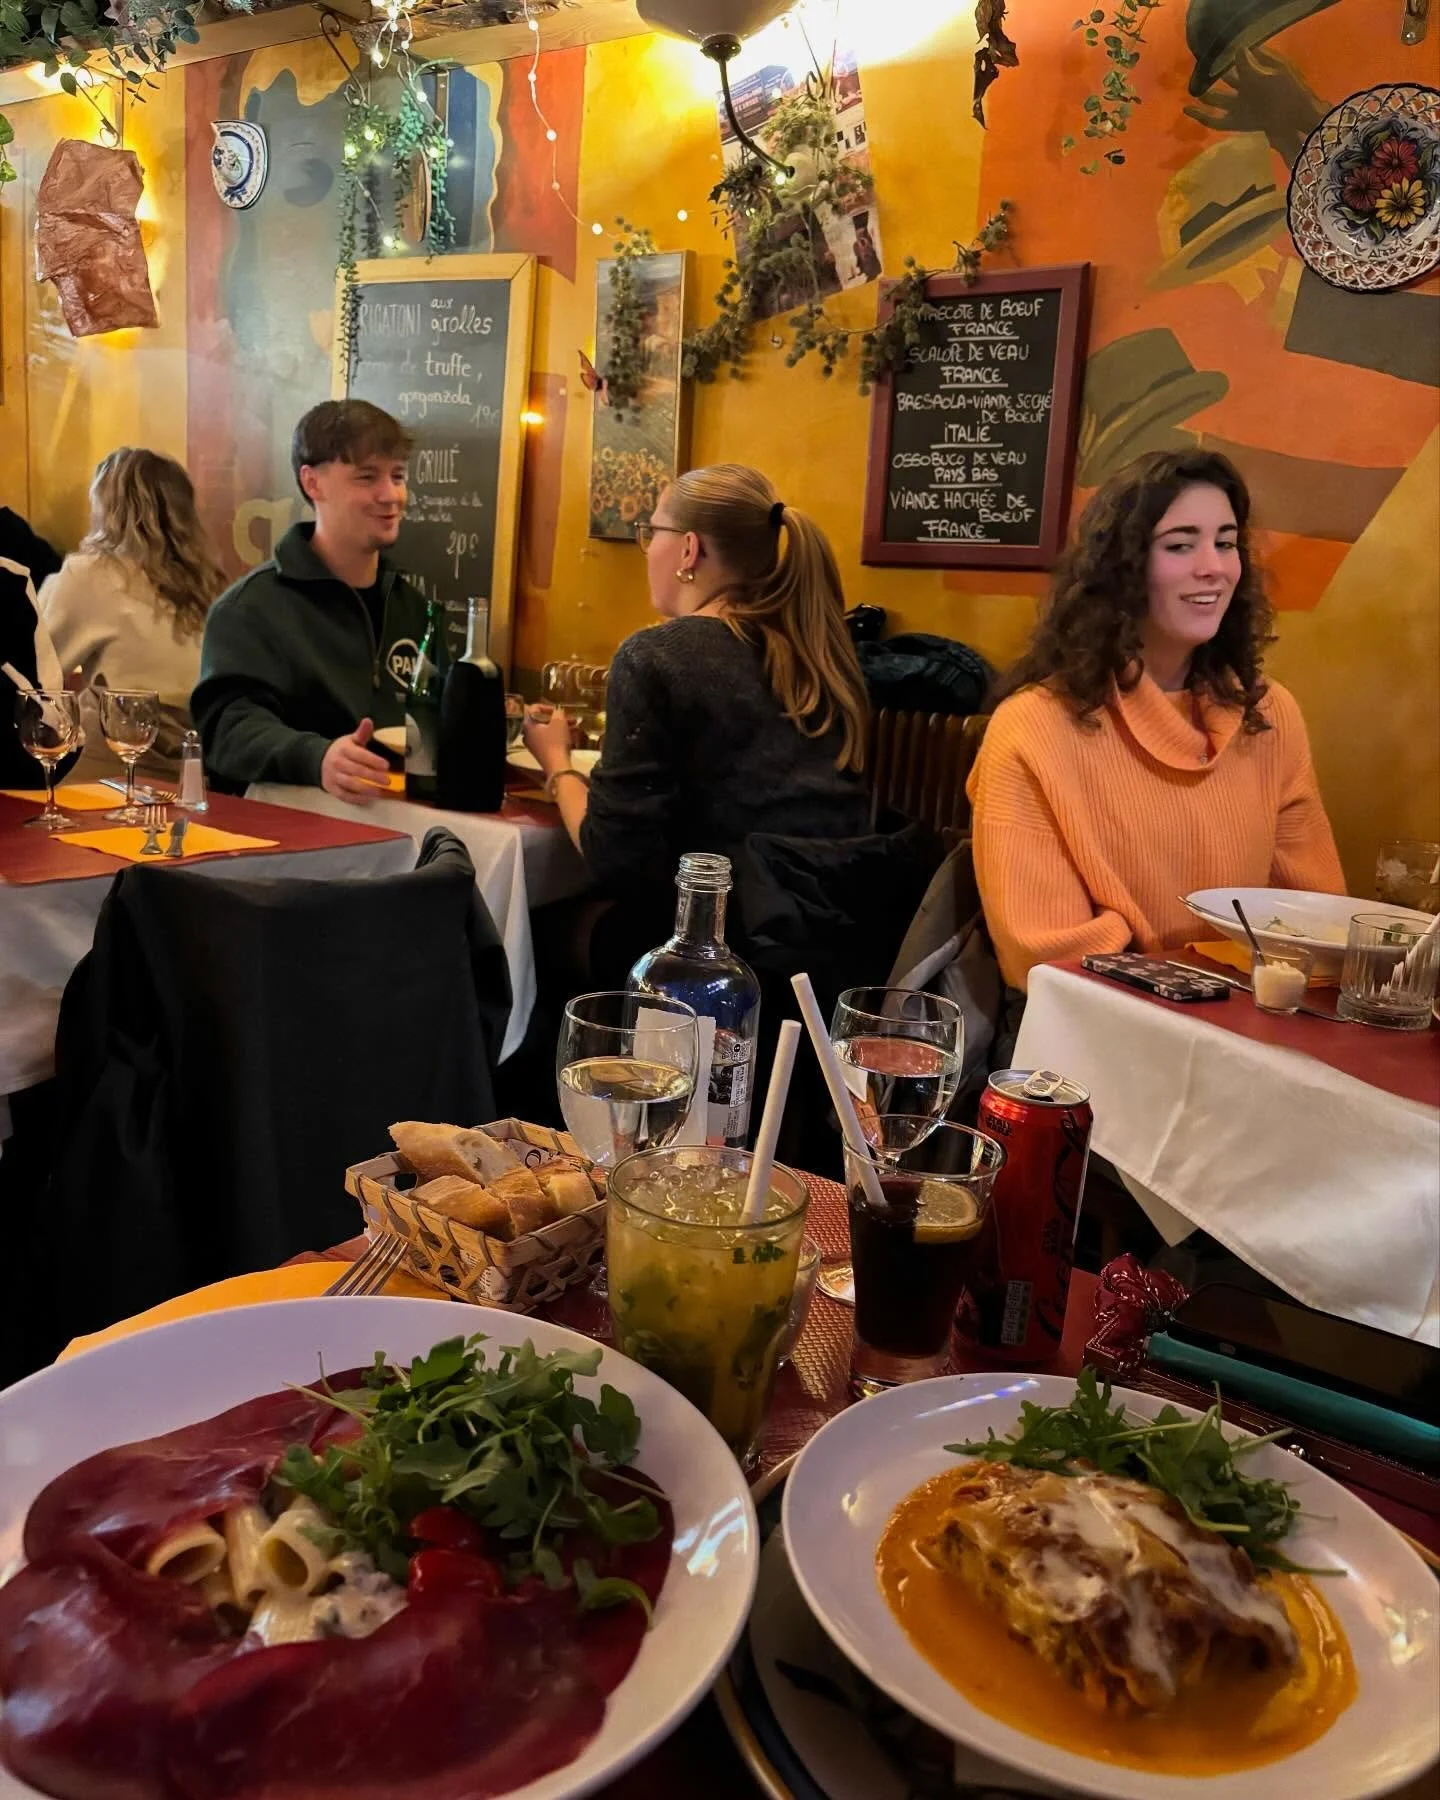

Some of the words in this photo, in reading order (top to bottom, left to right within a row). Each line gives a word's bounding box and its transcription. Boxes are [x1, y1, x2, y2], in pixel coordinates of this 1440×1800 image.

[980, 302, 995, 320] DE
[431, 304, 493, 346] girolles
[948, 320, 1015, 336] FRANCE
[967, 341, 984, 361] DE
[989, 344, 1030, 361] VEAU
[940, 365, 1002, 384] FRANCE
[981, 409, 1000, 424] DE
[892, 452, 966, 468] OSSOBUCO
[973, 452, 989, 465] DE
[990, 451, 1027, 465] VEAU
[933, 467, 966, 483] PAYS
[971, 467, 999, 482] BAS
[1006, 492, 1028, 510] DE
[922, 520, 986, 539] FRANCE
